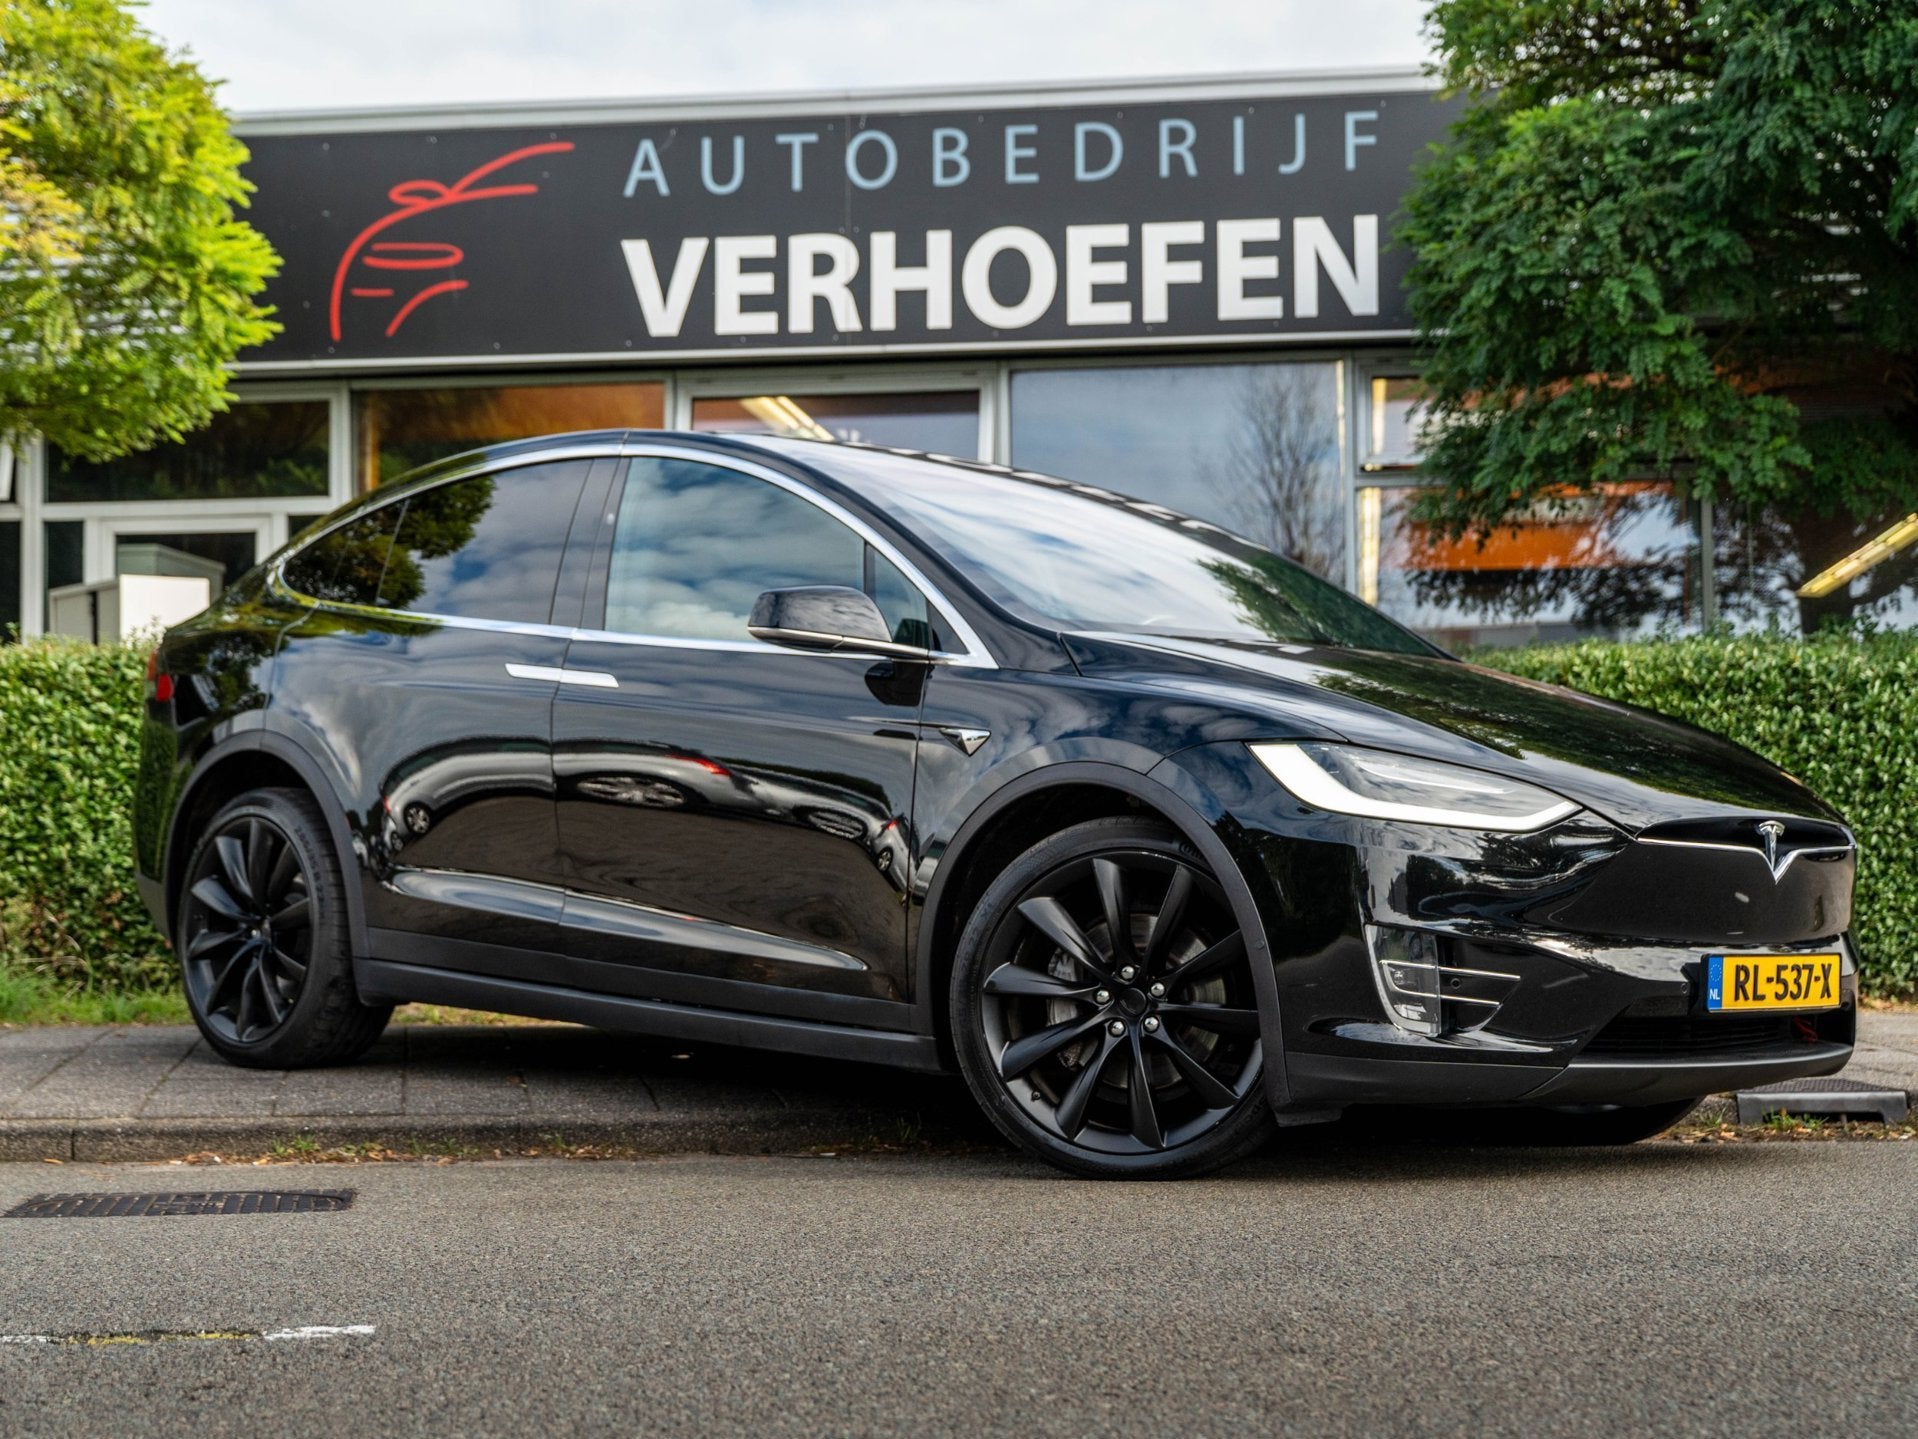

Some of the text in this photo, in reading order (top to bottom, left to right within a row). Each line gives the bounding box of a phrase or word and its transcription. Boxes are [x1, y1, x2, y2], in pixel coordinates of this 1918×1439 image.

[623, 110, 1379, 197] AUTOBEDRIJF
[621, 214, 1380, 337] VERHOEFEN
[1709, 989, 1720, 1000] NL
[1733, 963, 1832, 1002] RL-537-X
